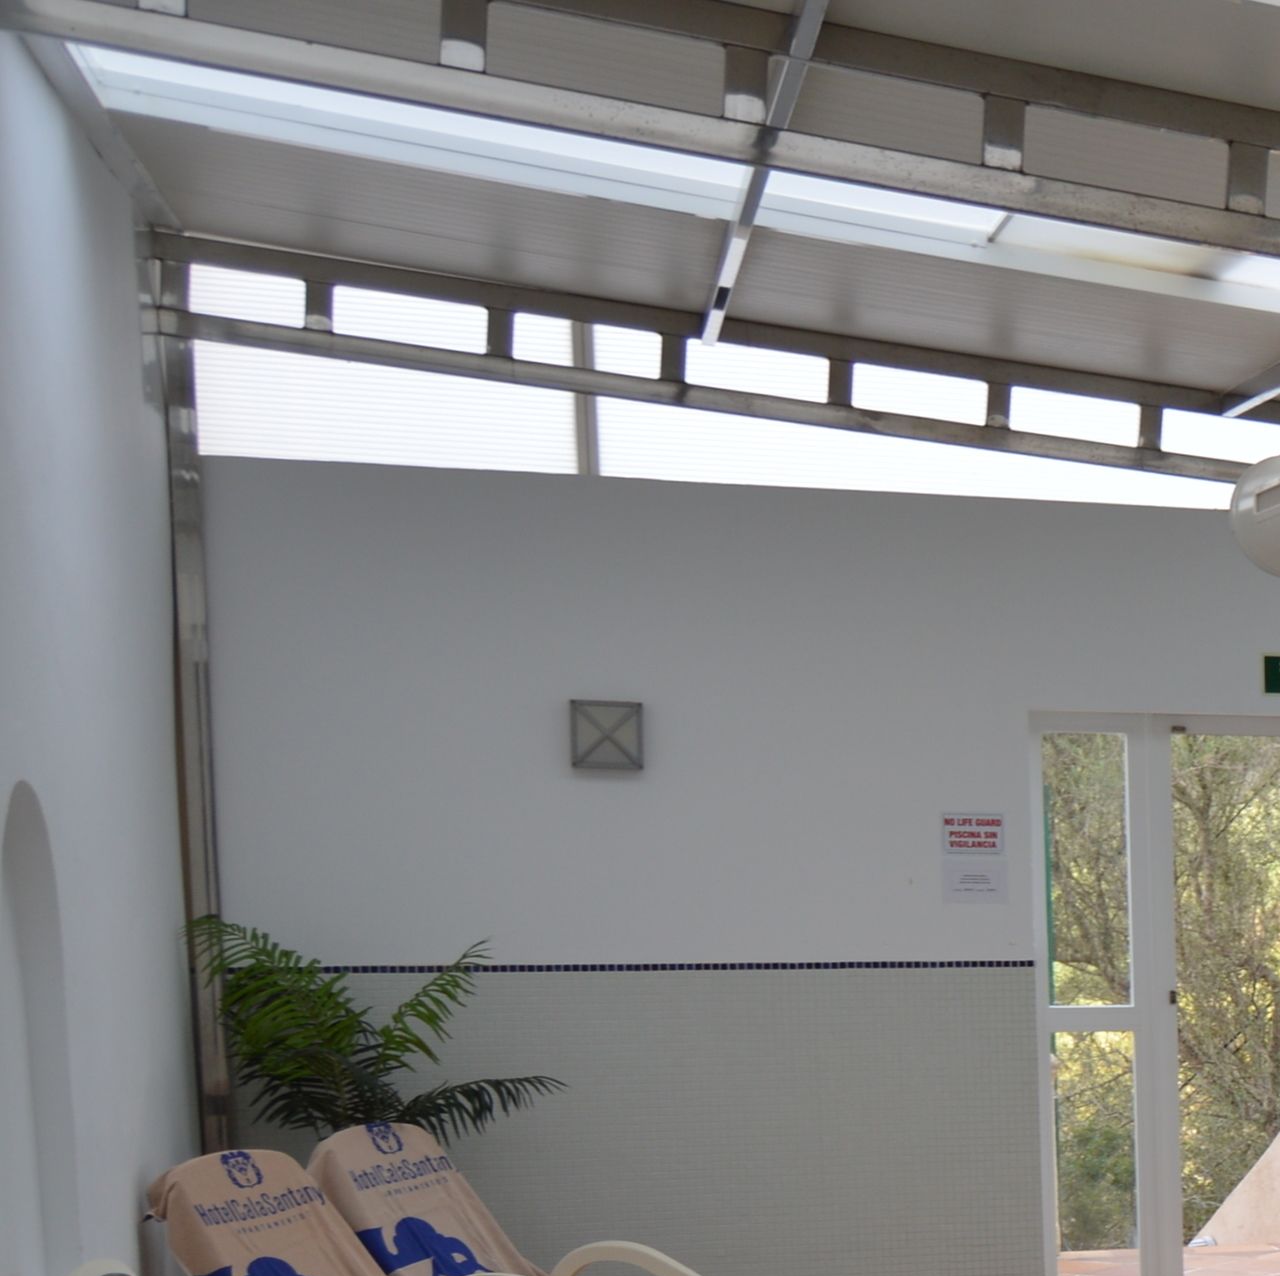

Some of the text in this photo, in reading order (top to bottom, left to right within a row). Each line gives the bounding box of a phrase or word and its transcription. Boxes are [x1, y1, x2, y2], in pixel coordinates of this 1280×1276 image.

[944, 819, 1002, 828] NO LIFE GUARD
[949, 831, 998, 840] PISCINA SIN
[949, 841, 997, 849] VIGILANCIA
